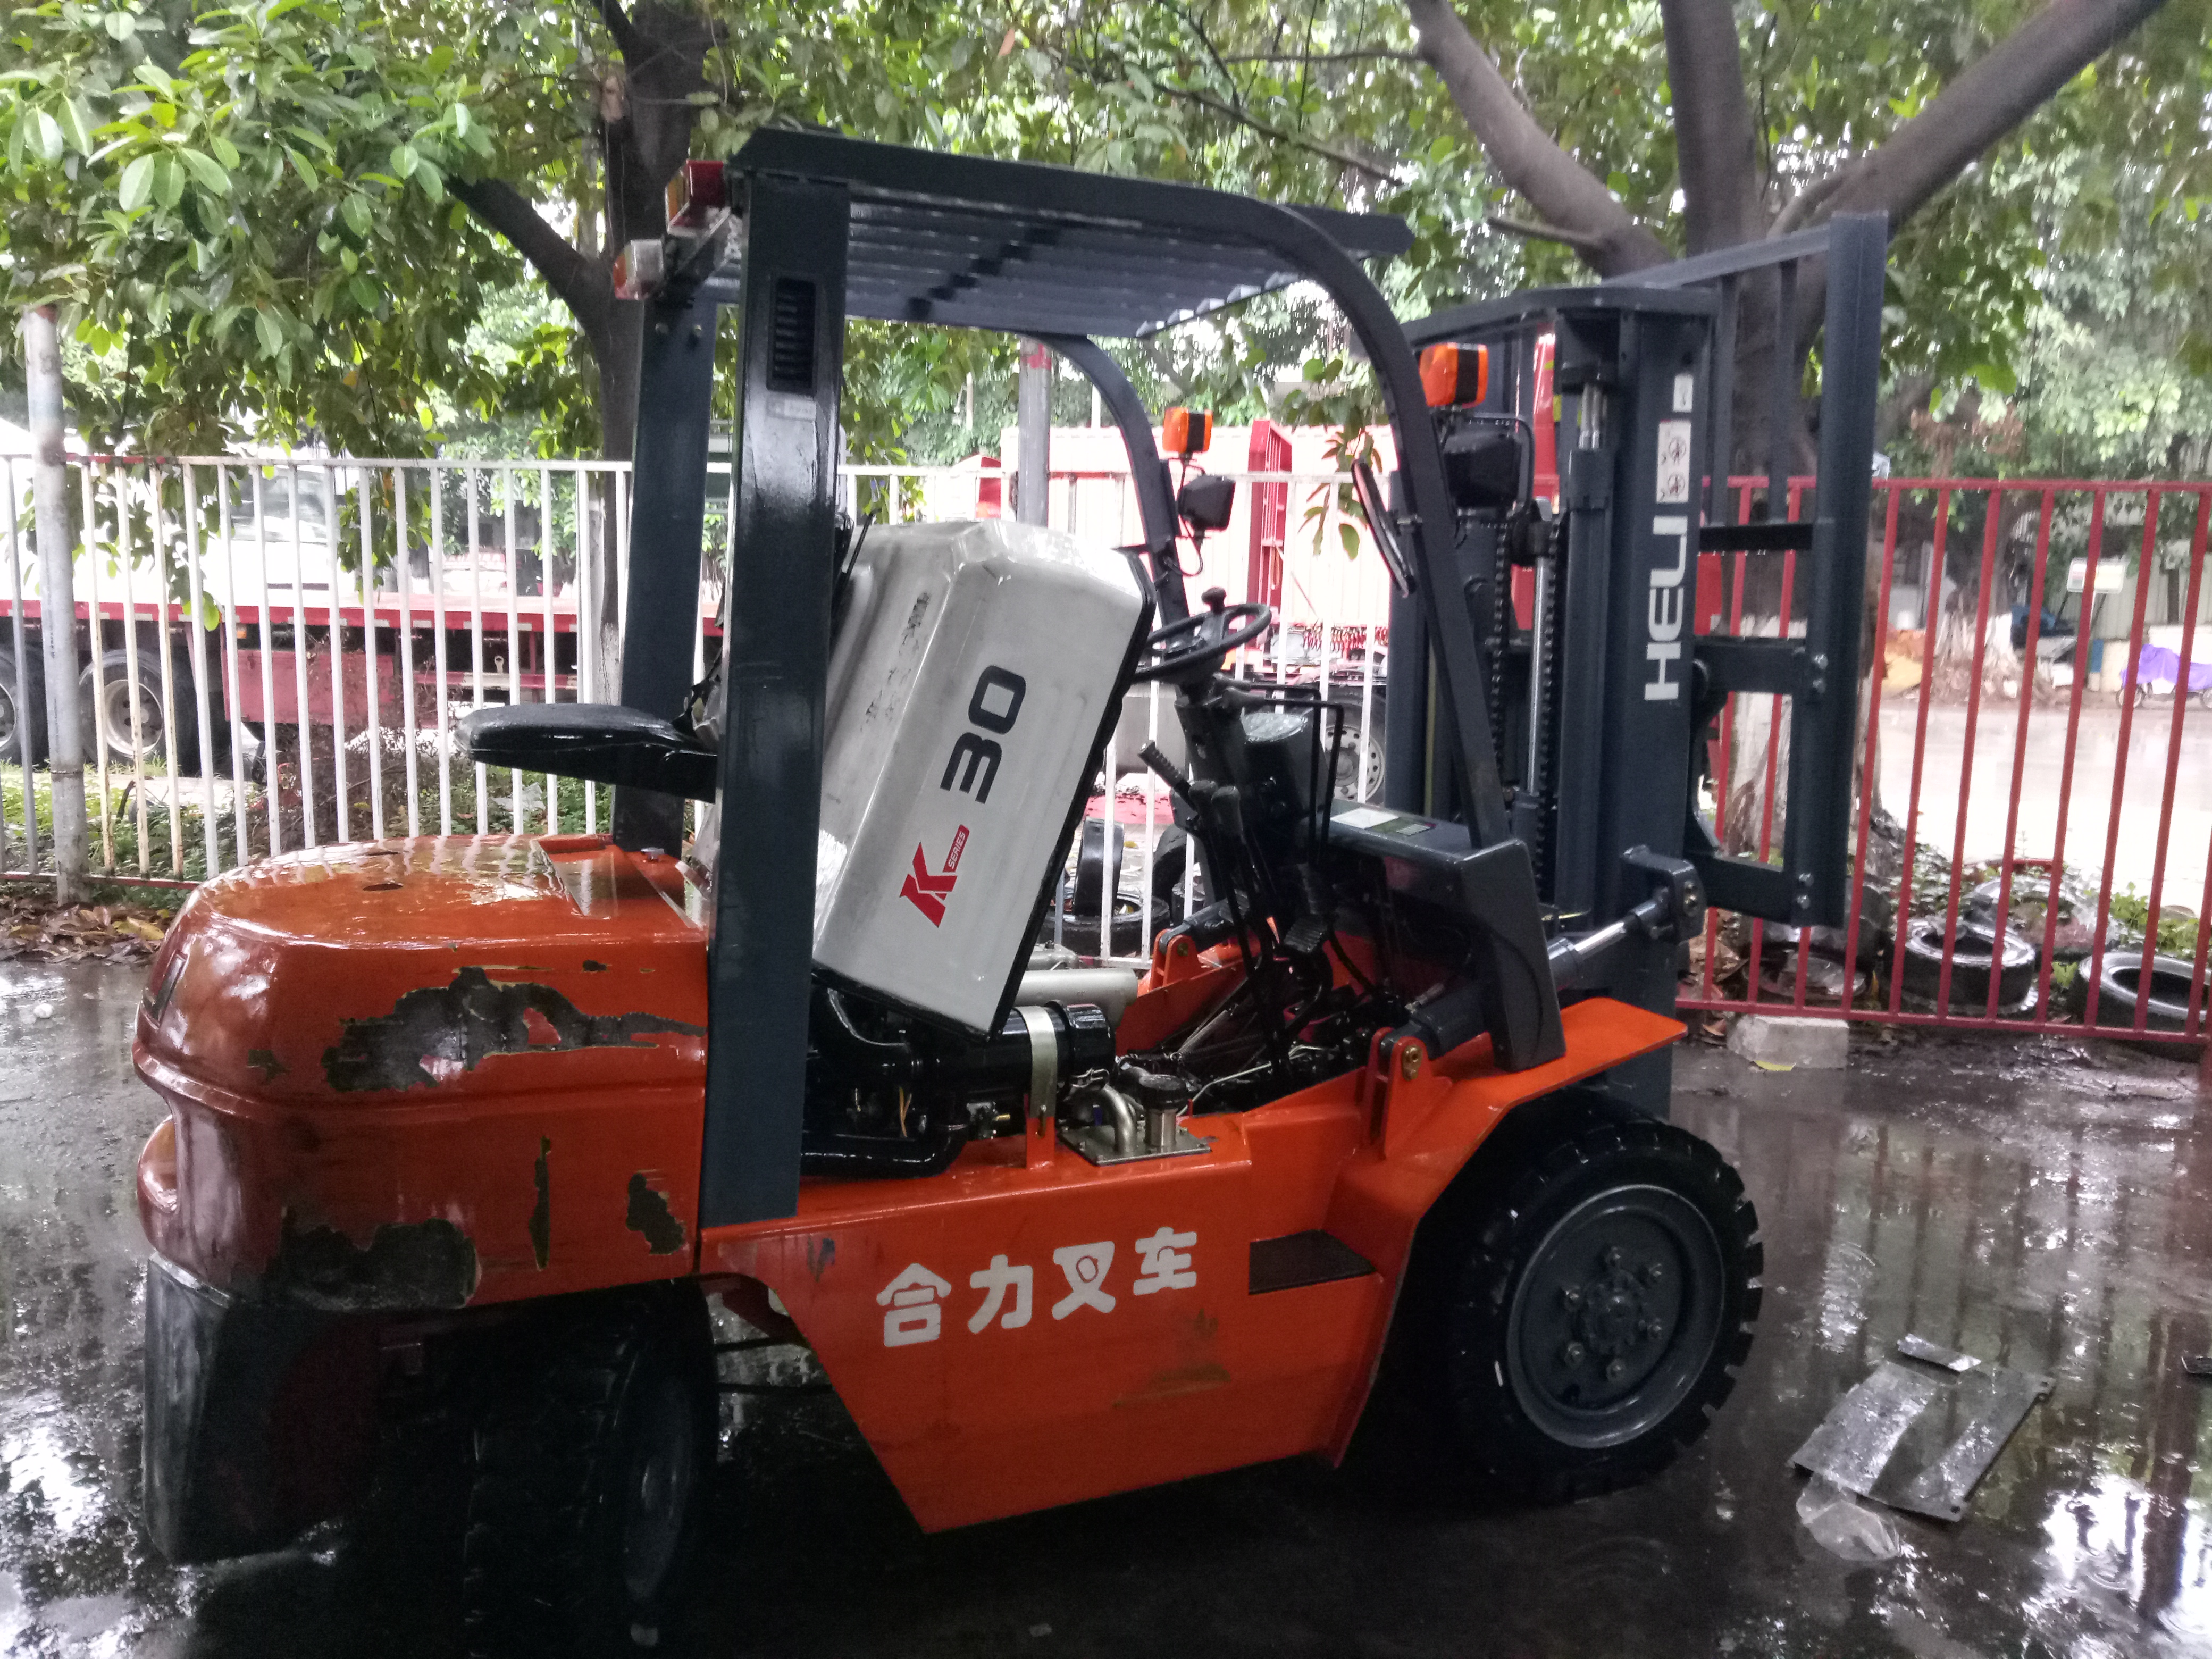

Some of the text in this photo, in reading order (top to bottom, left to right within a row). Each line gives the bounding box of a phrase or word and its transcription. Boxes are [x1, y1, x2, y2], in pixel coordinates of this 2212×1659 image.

[940, 665, 1026, 804] 30
[900, 831, 965, 927] K SERIES
[877, 1227, 1197, 1347] 合力叉车
